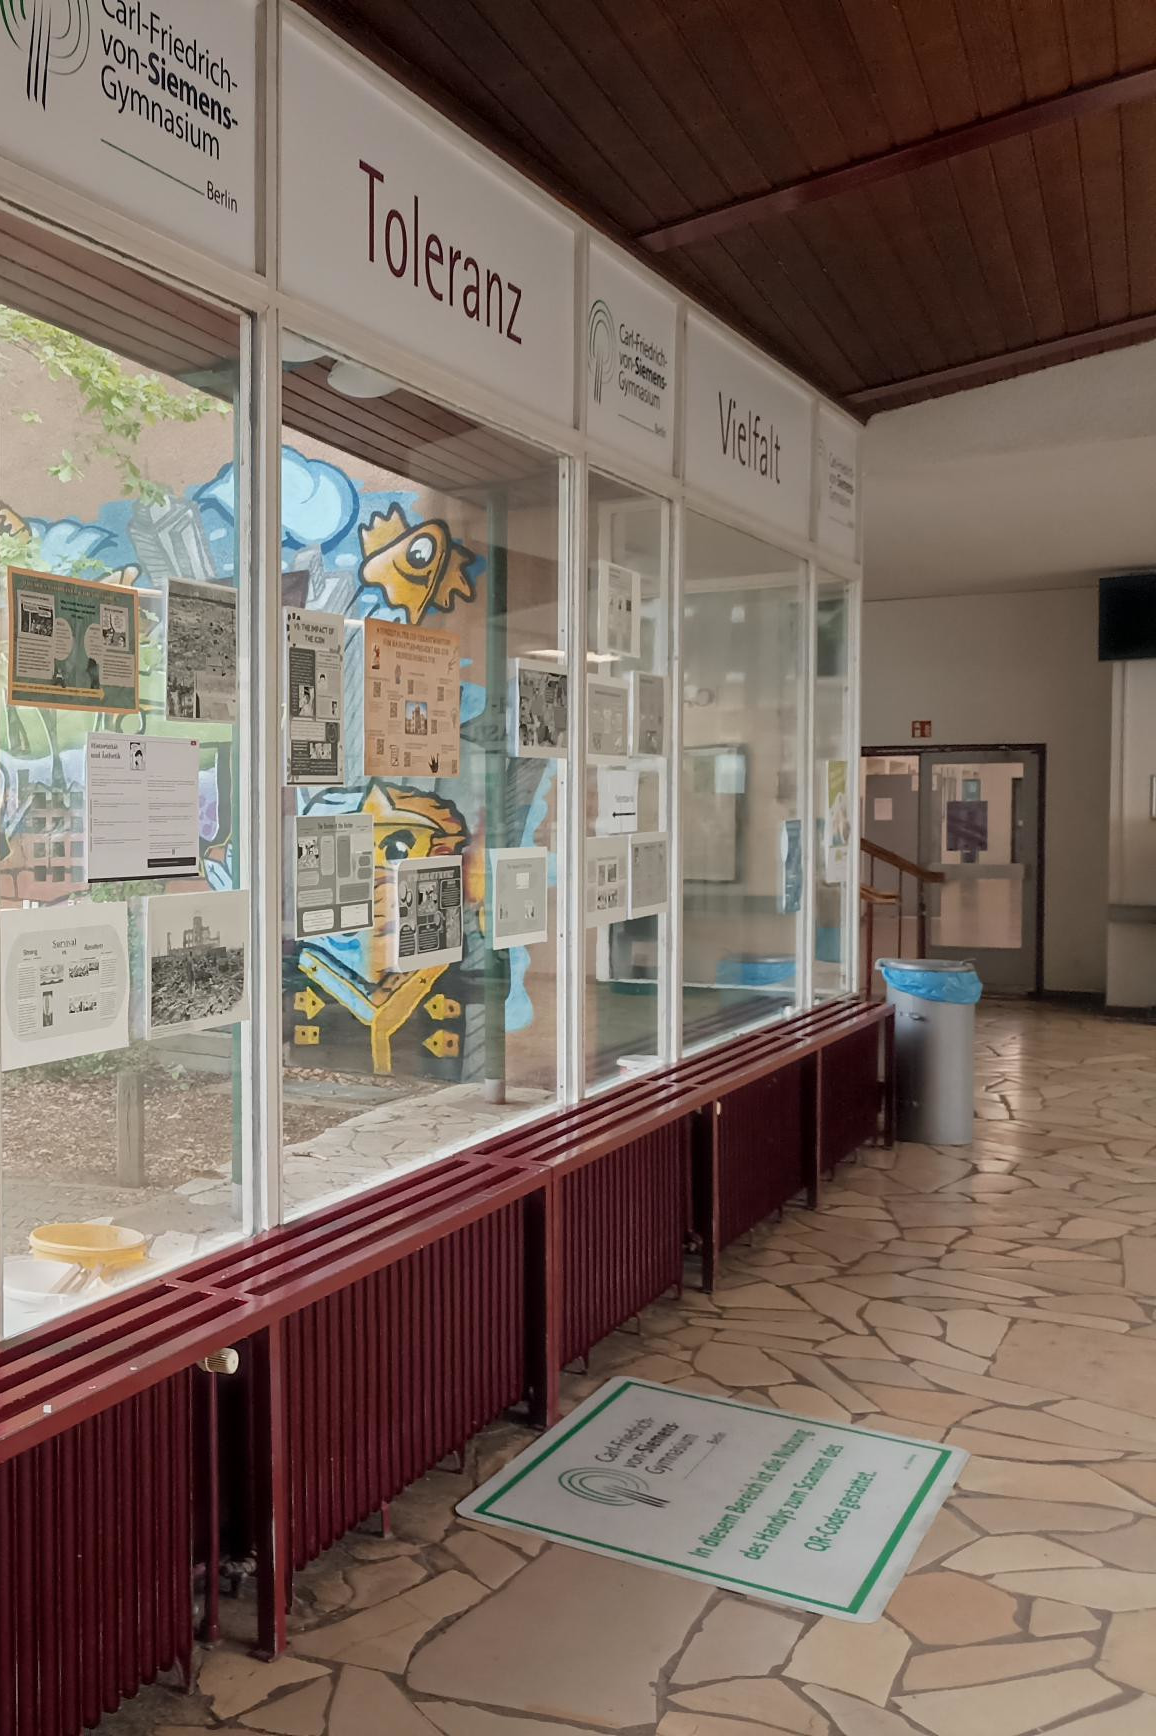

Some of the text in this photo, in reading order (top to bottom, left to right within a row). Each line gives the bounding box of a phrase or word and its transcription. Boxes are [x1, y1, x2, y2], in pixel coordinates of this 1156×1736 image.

[101, 28, 238, 129] von-Siemens-
[101, 65, 220, 160] Gymnasium
[207, 180, 238, 213] Berlin
[359, 159, 522, 345] Toleranz
[619, 323, 668, 368] Carl-Friedrich-
[619, 350, 668, 390] von-Siemens-
[619, 370, 661, 410] Gymnasium
[719, 391, 781, 484] Vielfalt
[687, 1428, 816, 1560] In diesem Bereich ist die Nutzung
[739, 1443, 845, 1561] des Handys zum Scannen des
[803, 1508, 851, 1553] QR-Codes
